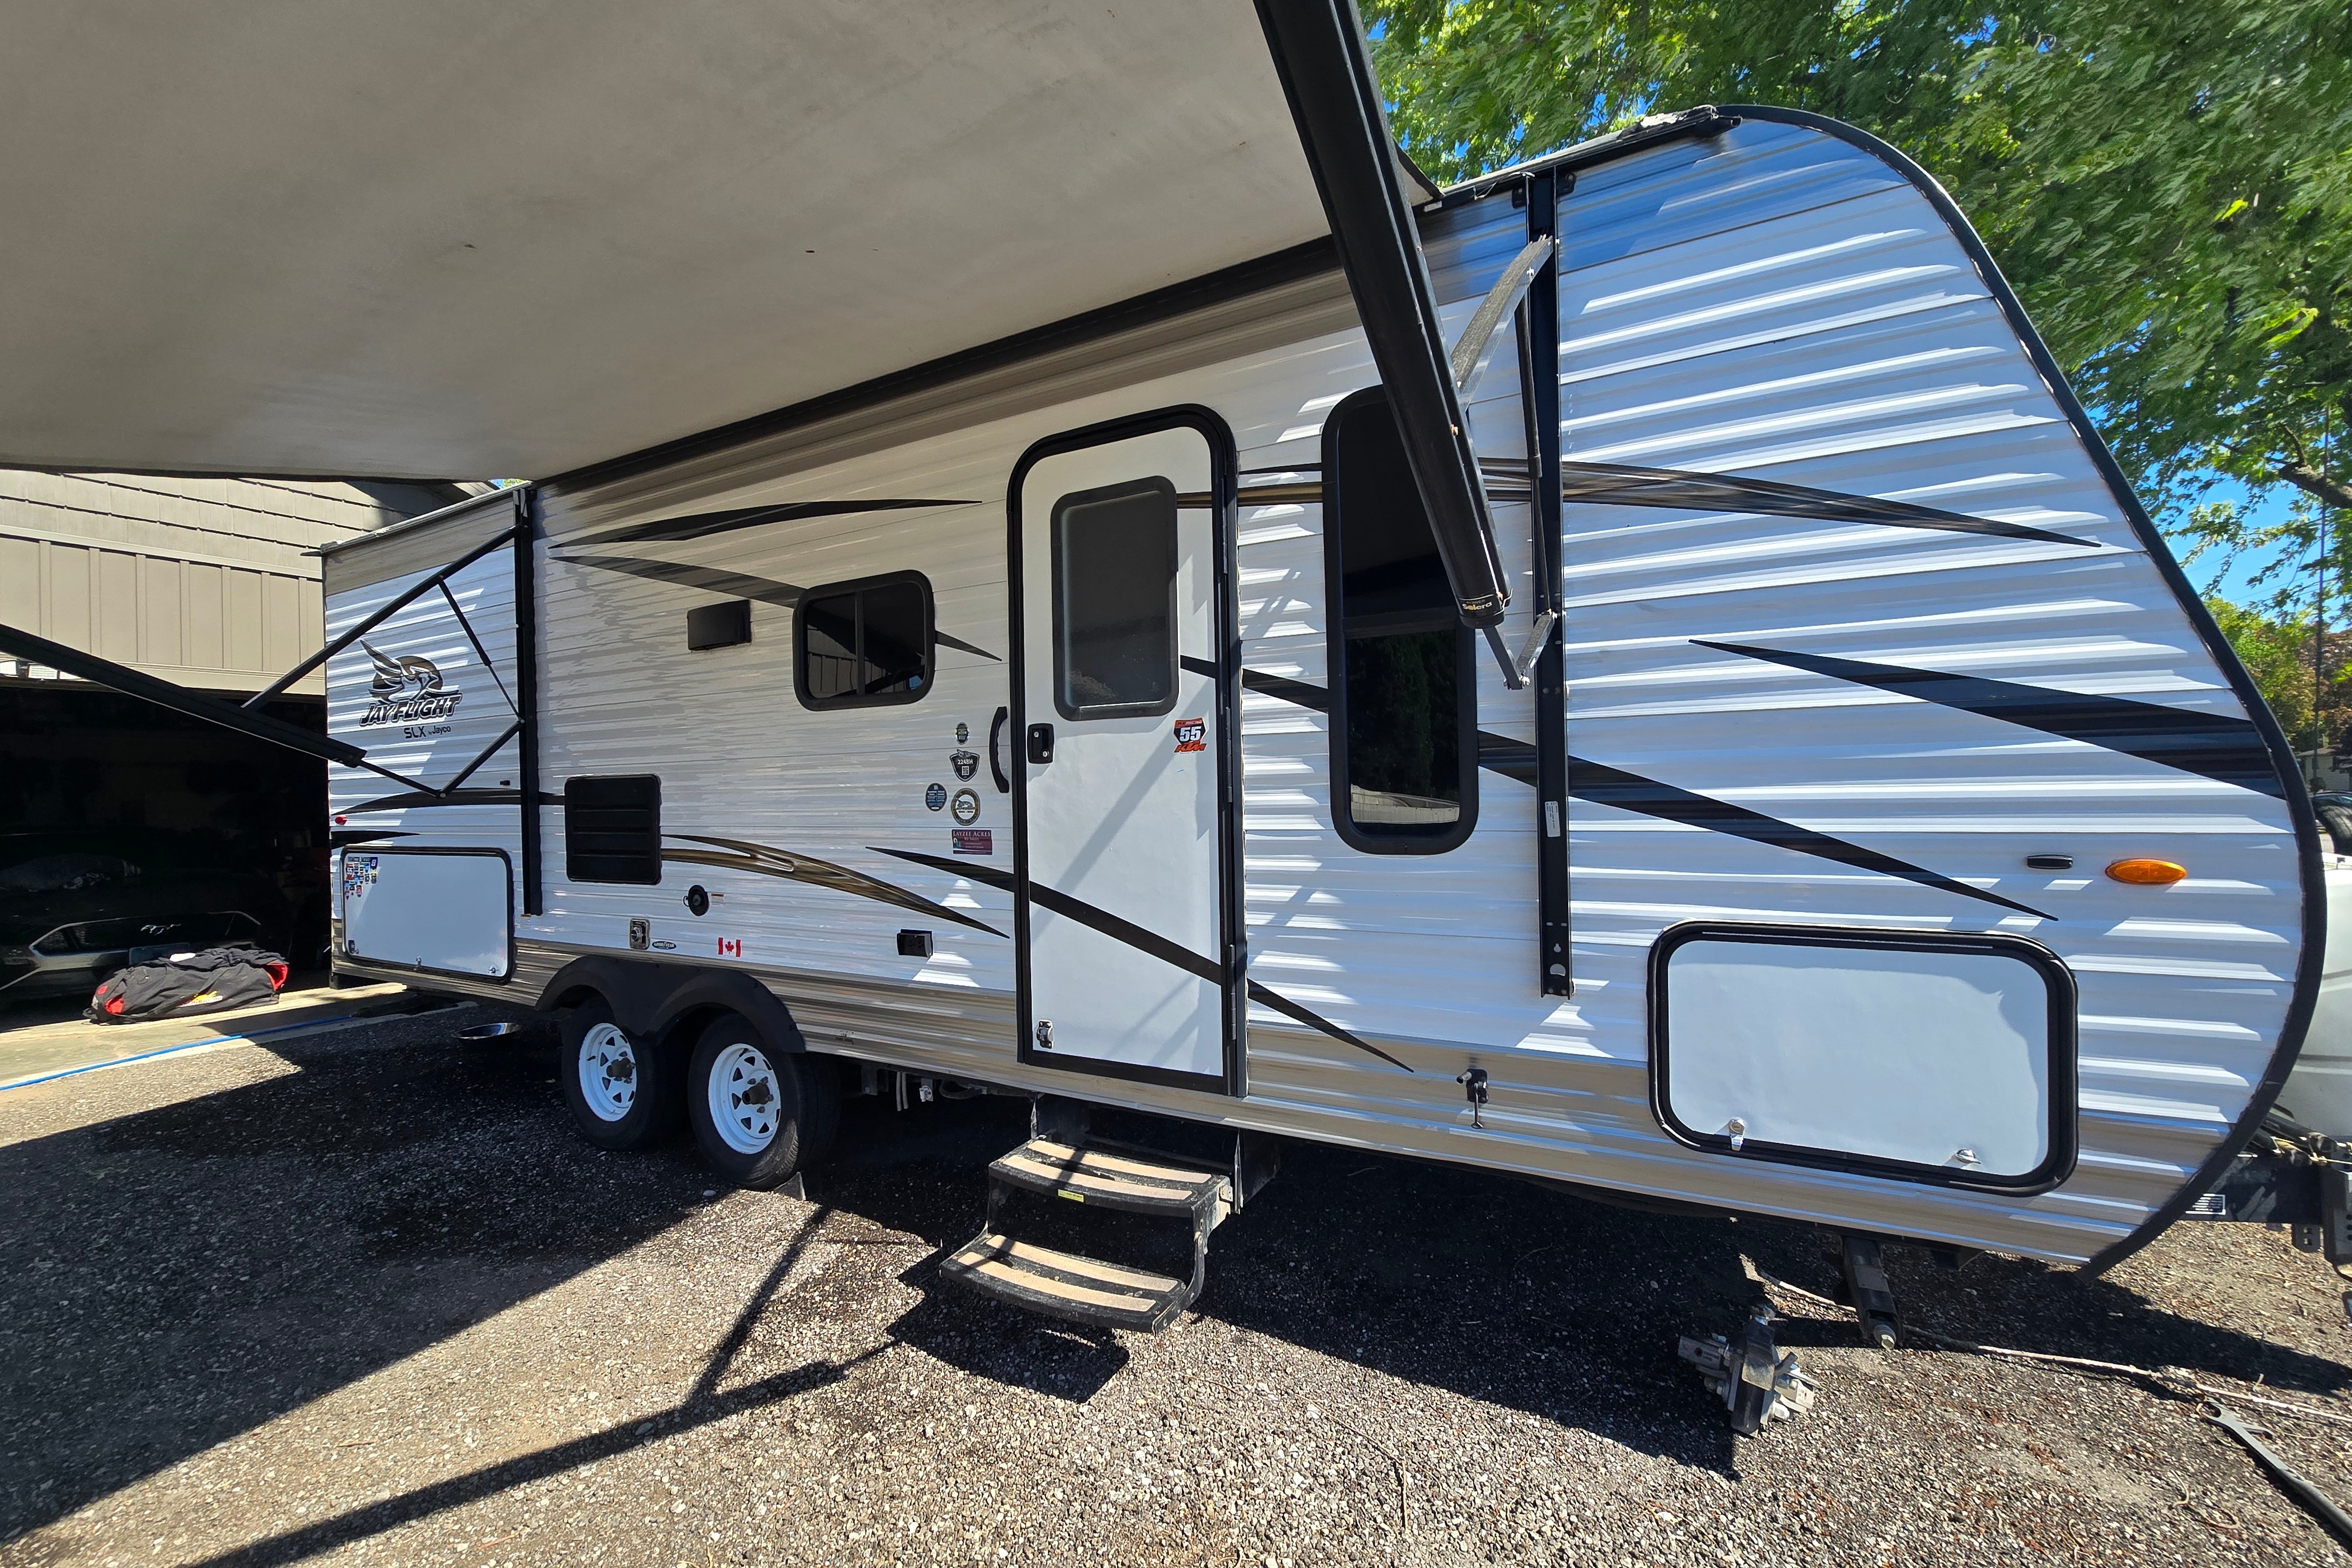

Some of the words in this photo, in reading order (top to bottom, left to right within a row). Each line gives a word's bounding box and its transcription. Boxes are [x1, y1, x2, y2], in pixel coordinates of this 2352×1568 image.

[1462, 601, 1492, 610] Solera
[404, 726, 426, 739] SLX
[432, 726, 451, 735] Jayco
[1180, 726, 1202, 742] 55
[1174, 743, 1207, 753] KTM
